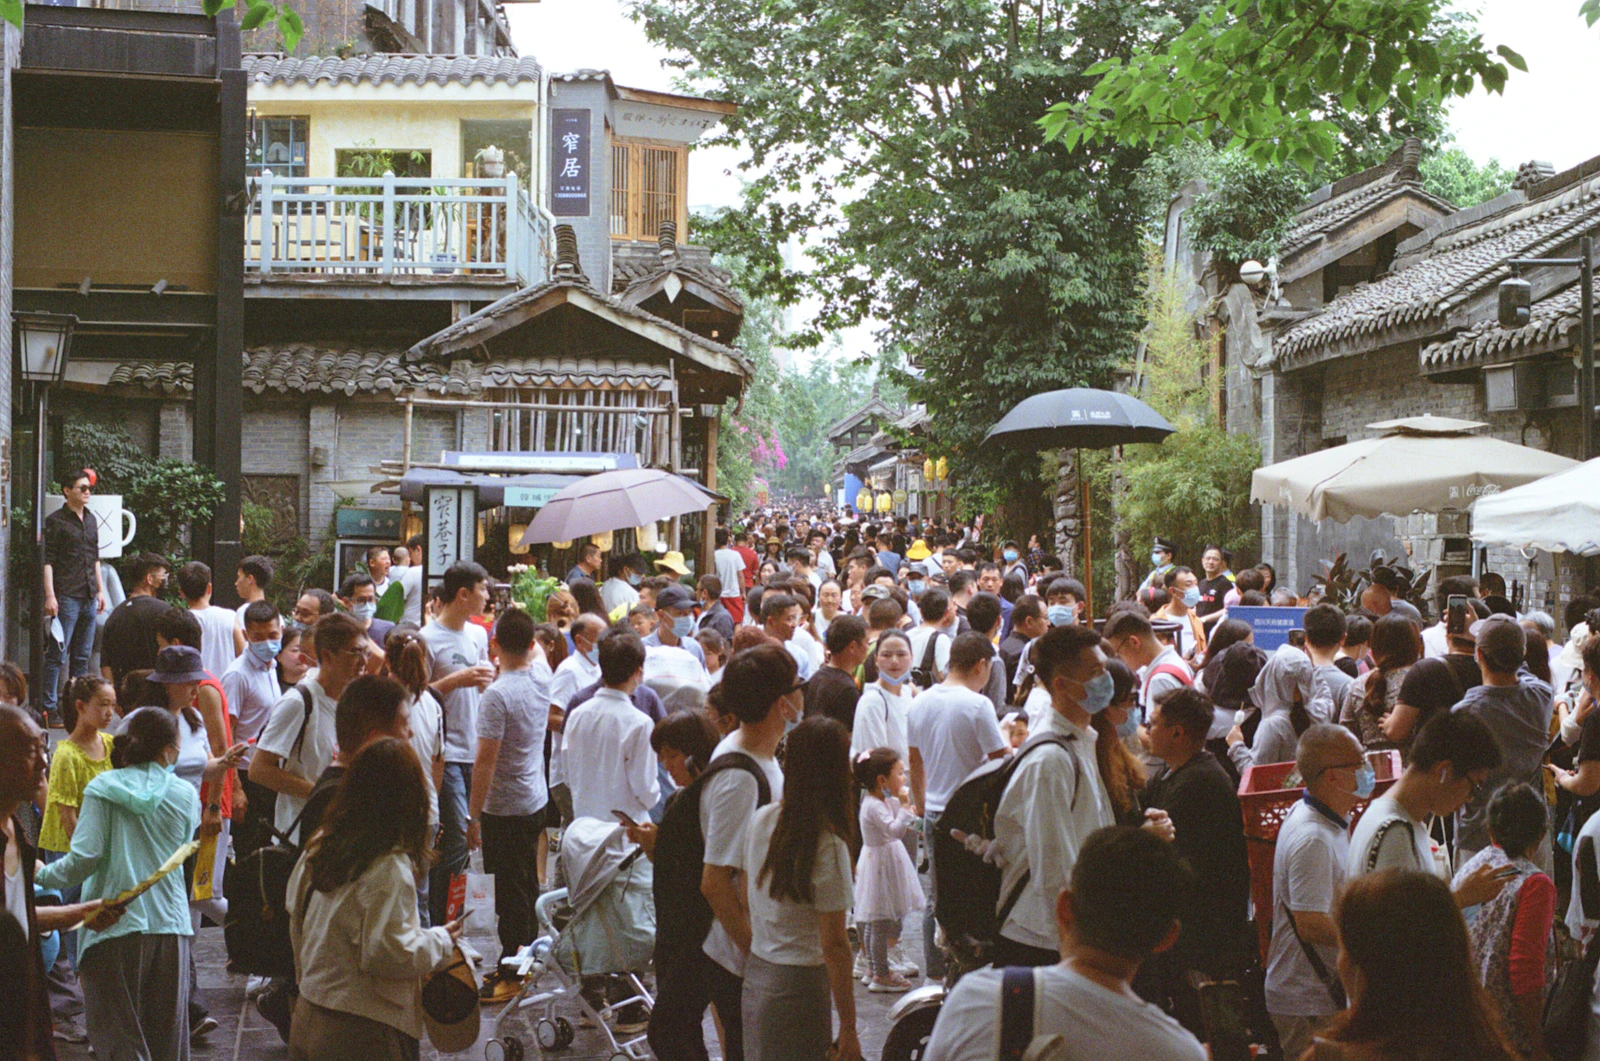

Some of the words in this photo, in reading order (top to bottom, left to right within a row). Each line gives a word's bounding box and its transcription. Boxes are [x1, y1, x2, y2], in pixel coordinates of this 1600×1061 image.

[560, 132, 582, 178] 窄居
[434, 495, 453, 566] 窄巷子
